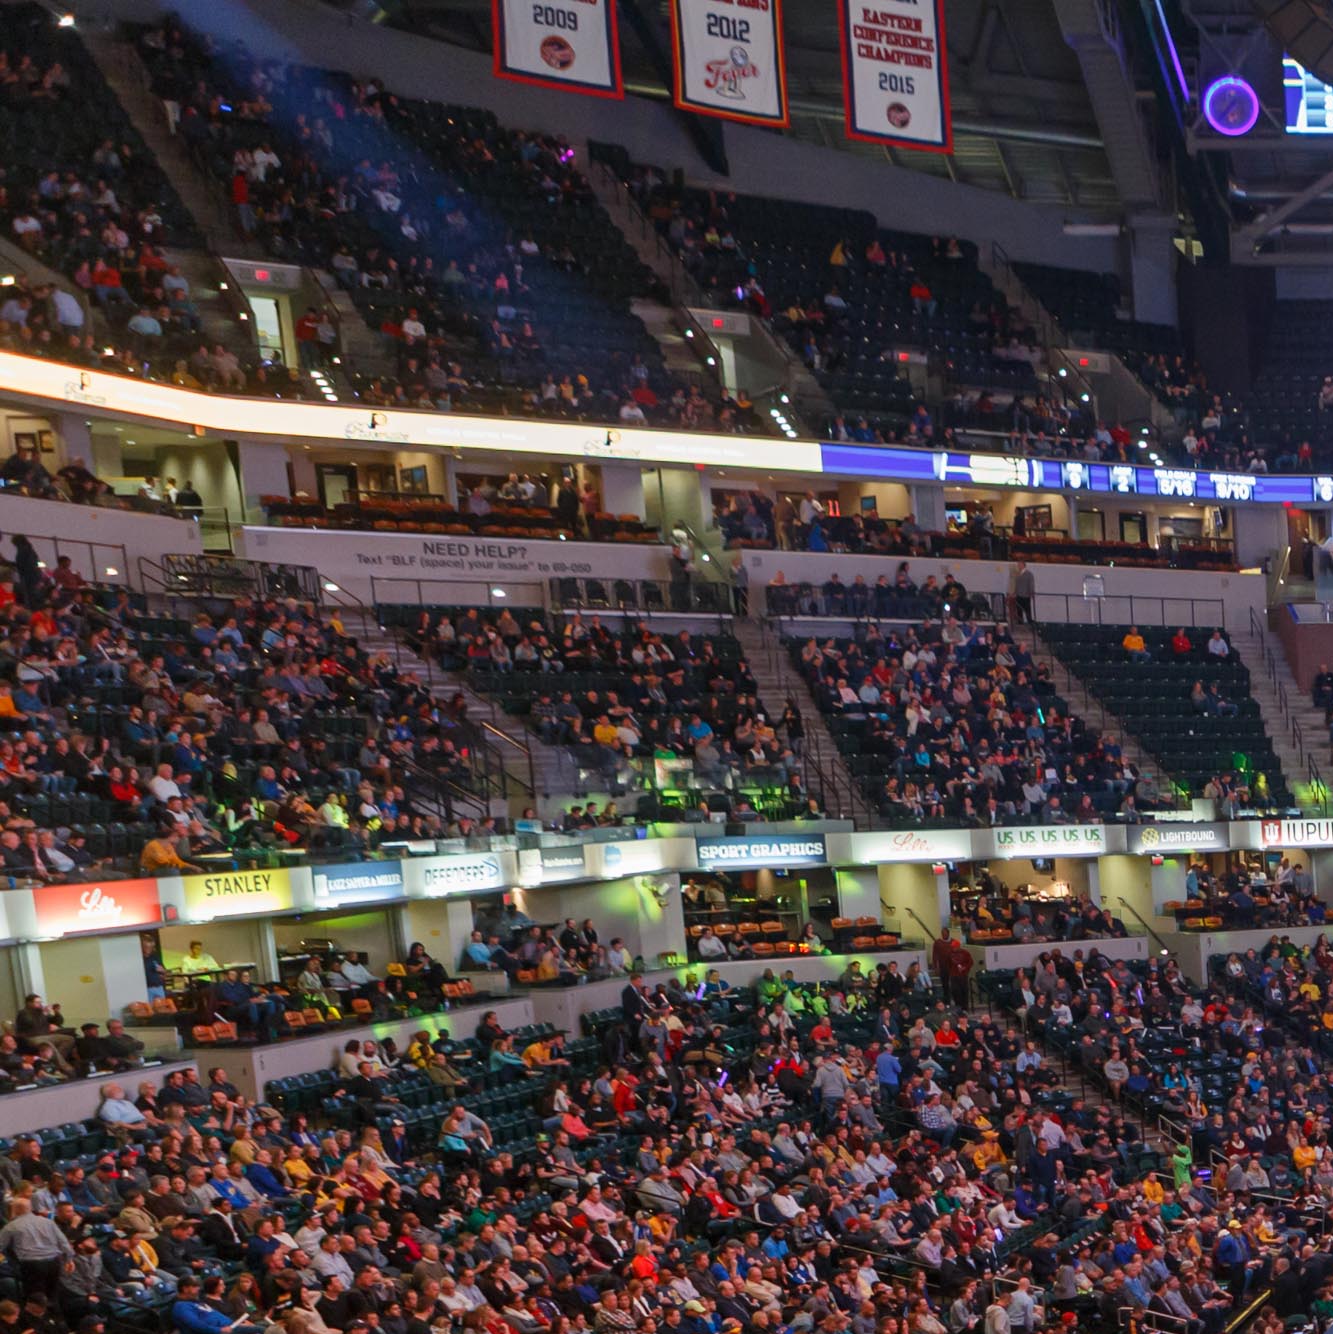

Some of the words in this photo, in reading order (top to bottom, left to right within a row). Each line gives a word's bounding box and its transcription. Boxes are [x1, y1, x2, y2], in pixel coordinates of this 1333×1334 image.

[533, 5, 578, 31] 2009
[706, 13, 751, 43] 2012
[862, 8, 923, 33] EASTERN
[853, 24, 935, 52] CONFERENCE
[857, 43, 933, 69] CHAMPIONS
[878, 72, 915, 95] 2015
[1117, 476, 1129, 492] 2
[423, 542, 470, 557] NEED
[475, 544, 528, 560] HELP?
[357, 553, 383, 565] Text
[468, 561, 494, 572] your
[538, 562, 550, 571] to
[700, 844, 748, 859] SPORT
[751, 842, 824, 858] GRAPHICS
[206, 874, 272, 896] STANLEY
[425, 865, 485, 885] DEFENDERS
